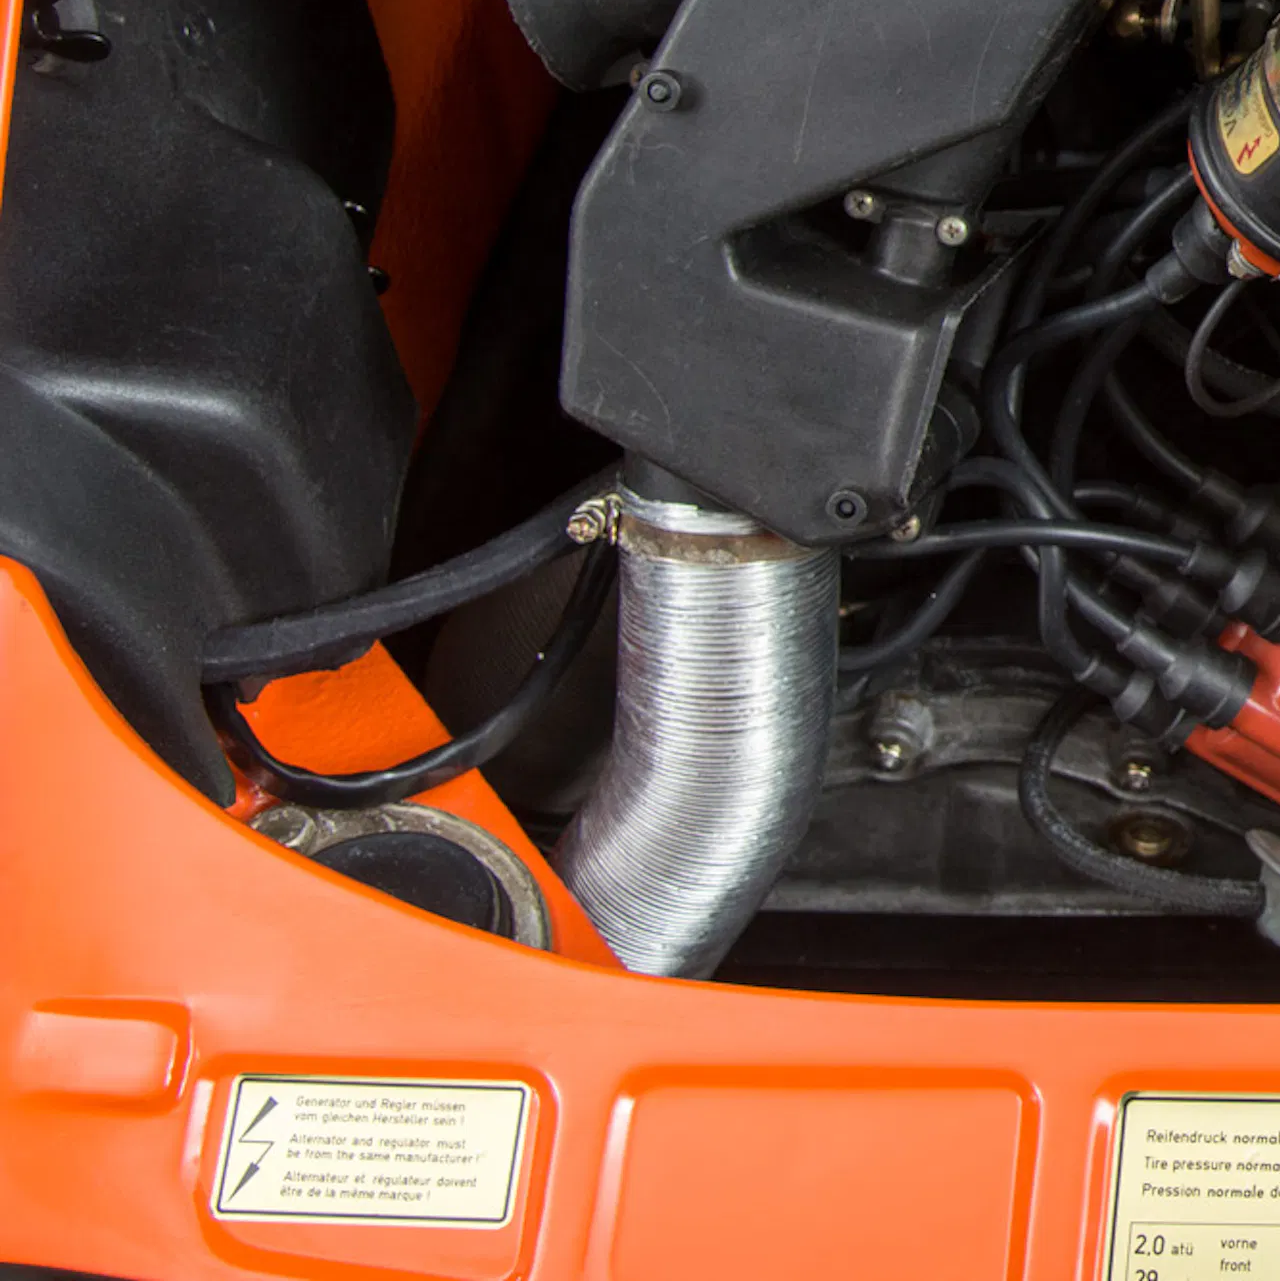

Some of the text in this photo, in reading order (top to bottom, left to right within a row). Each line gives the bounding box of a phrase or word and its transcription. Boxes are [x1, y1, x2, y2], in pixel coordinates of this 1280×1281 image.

[296, 1095, 351, 1109] Generator
[355, 1099, 377, 1109] und
[380, 1098, 417, 1112] Regler
[294, 1111, 457, 1126] vom gleichen Hersteller sein
[289, 1132, 466, 1150] Alternator and regulator must
[1146, 1128, 1227, 1144] Reifendruck
[286, 1148, 473, 1165] be from the same manufacturer
[1144, 1155, 1168, 1170] Tire
[1172, 1159, 1232, 1174] pressure
[283, 1170, 349, 1184] Alternateur
[354, 1174, 366, 1184] et
[436, 1176, 477, 1188] doivent
[307, 1186, 322, 1198] de
[325, 1186, 336, 1198] la
[378, 1190, 423, 1202] marque
[1141, 1182, 1200, 1198] Pression
[1207, 1184, 1264, 1199] normale
[1170, 1242, 1194, 1257] atü
[1220, 1238, 1258, 1251] vorne
[1219, 1257, 1251, 1272] front
